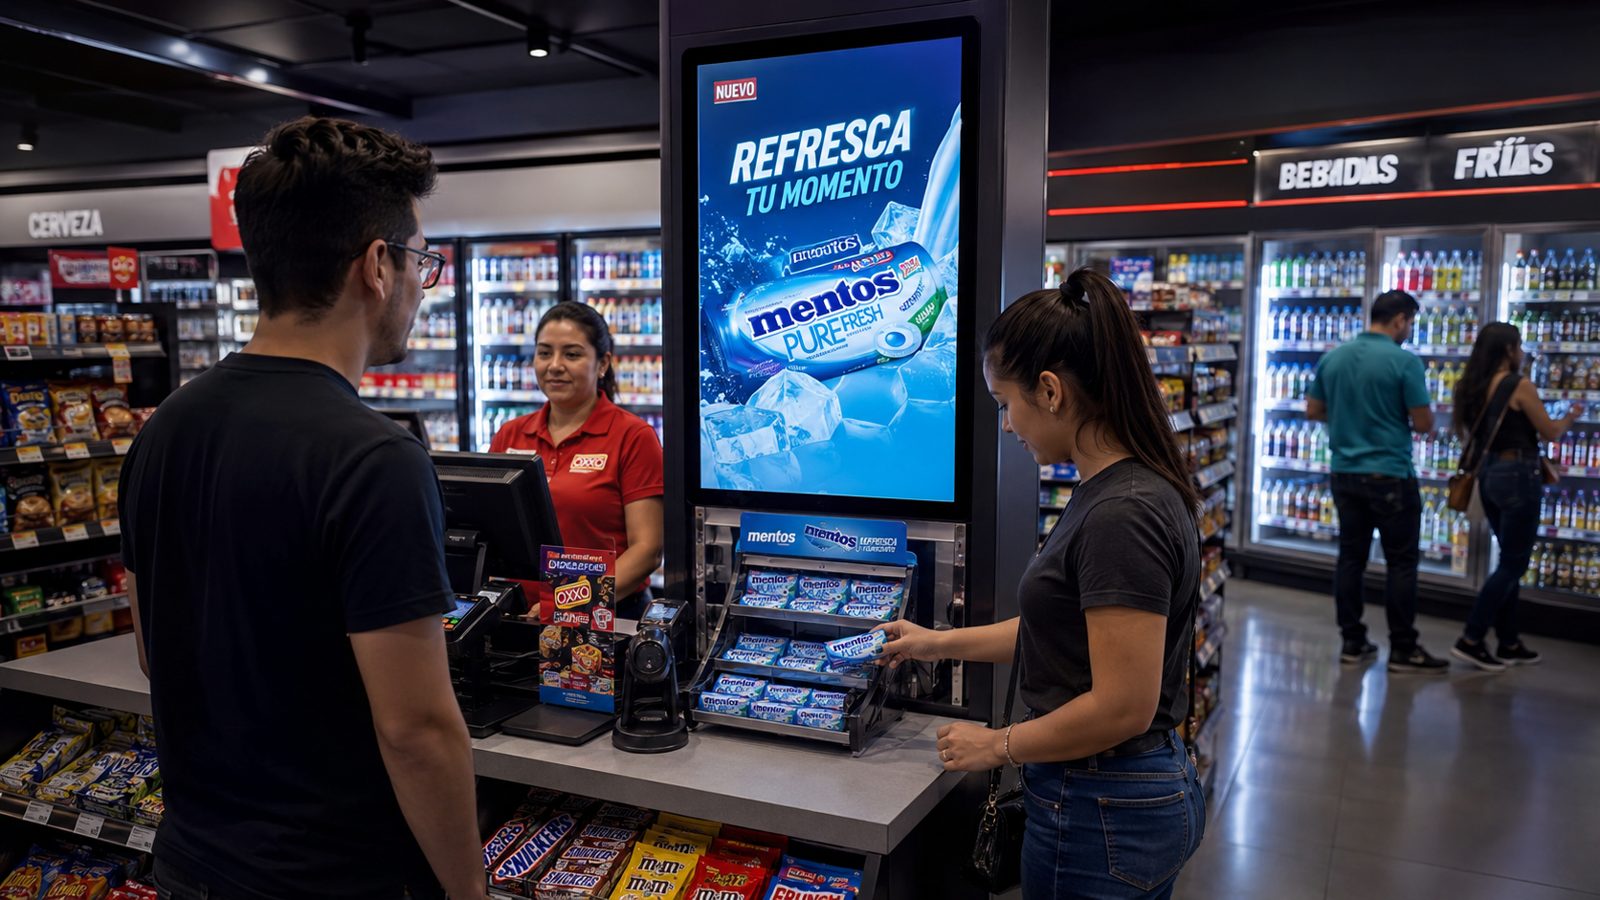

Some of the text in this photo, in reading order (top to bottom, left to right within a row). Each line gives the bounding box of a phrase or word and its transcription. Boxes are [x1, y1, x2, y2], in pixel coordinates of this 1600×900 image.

[716, 82, 755, 100] NUEVO
[729, 109, 911, 185] REFRESCA
[746, 159, 904, 216] TU MOMENTO
[28, 209, 104, 239] CERVEZA
[747, 269, 902, 341] mentos
[782, 319, 846, 362] PURE
[843, 303, 884, 333] FRESH
[574, 456, 606, 468] OXXO
[747, 530, 796, 543] mentos
[557, 585, 589, 605] OXXO
